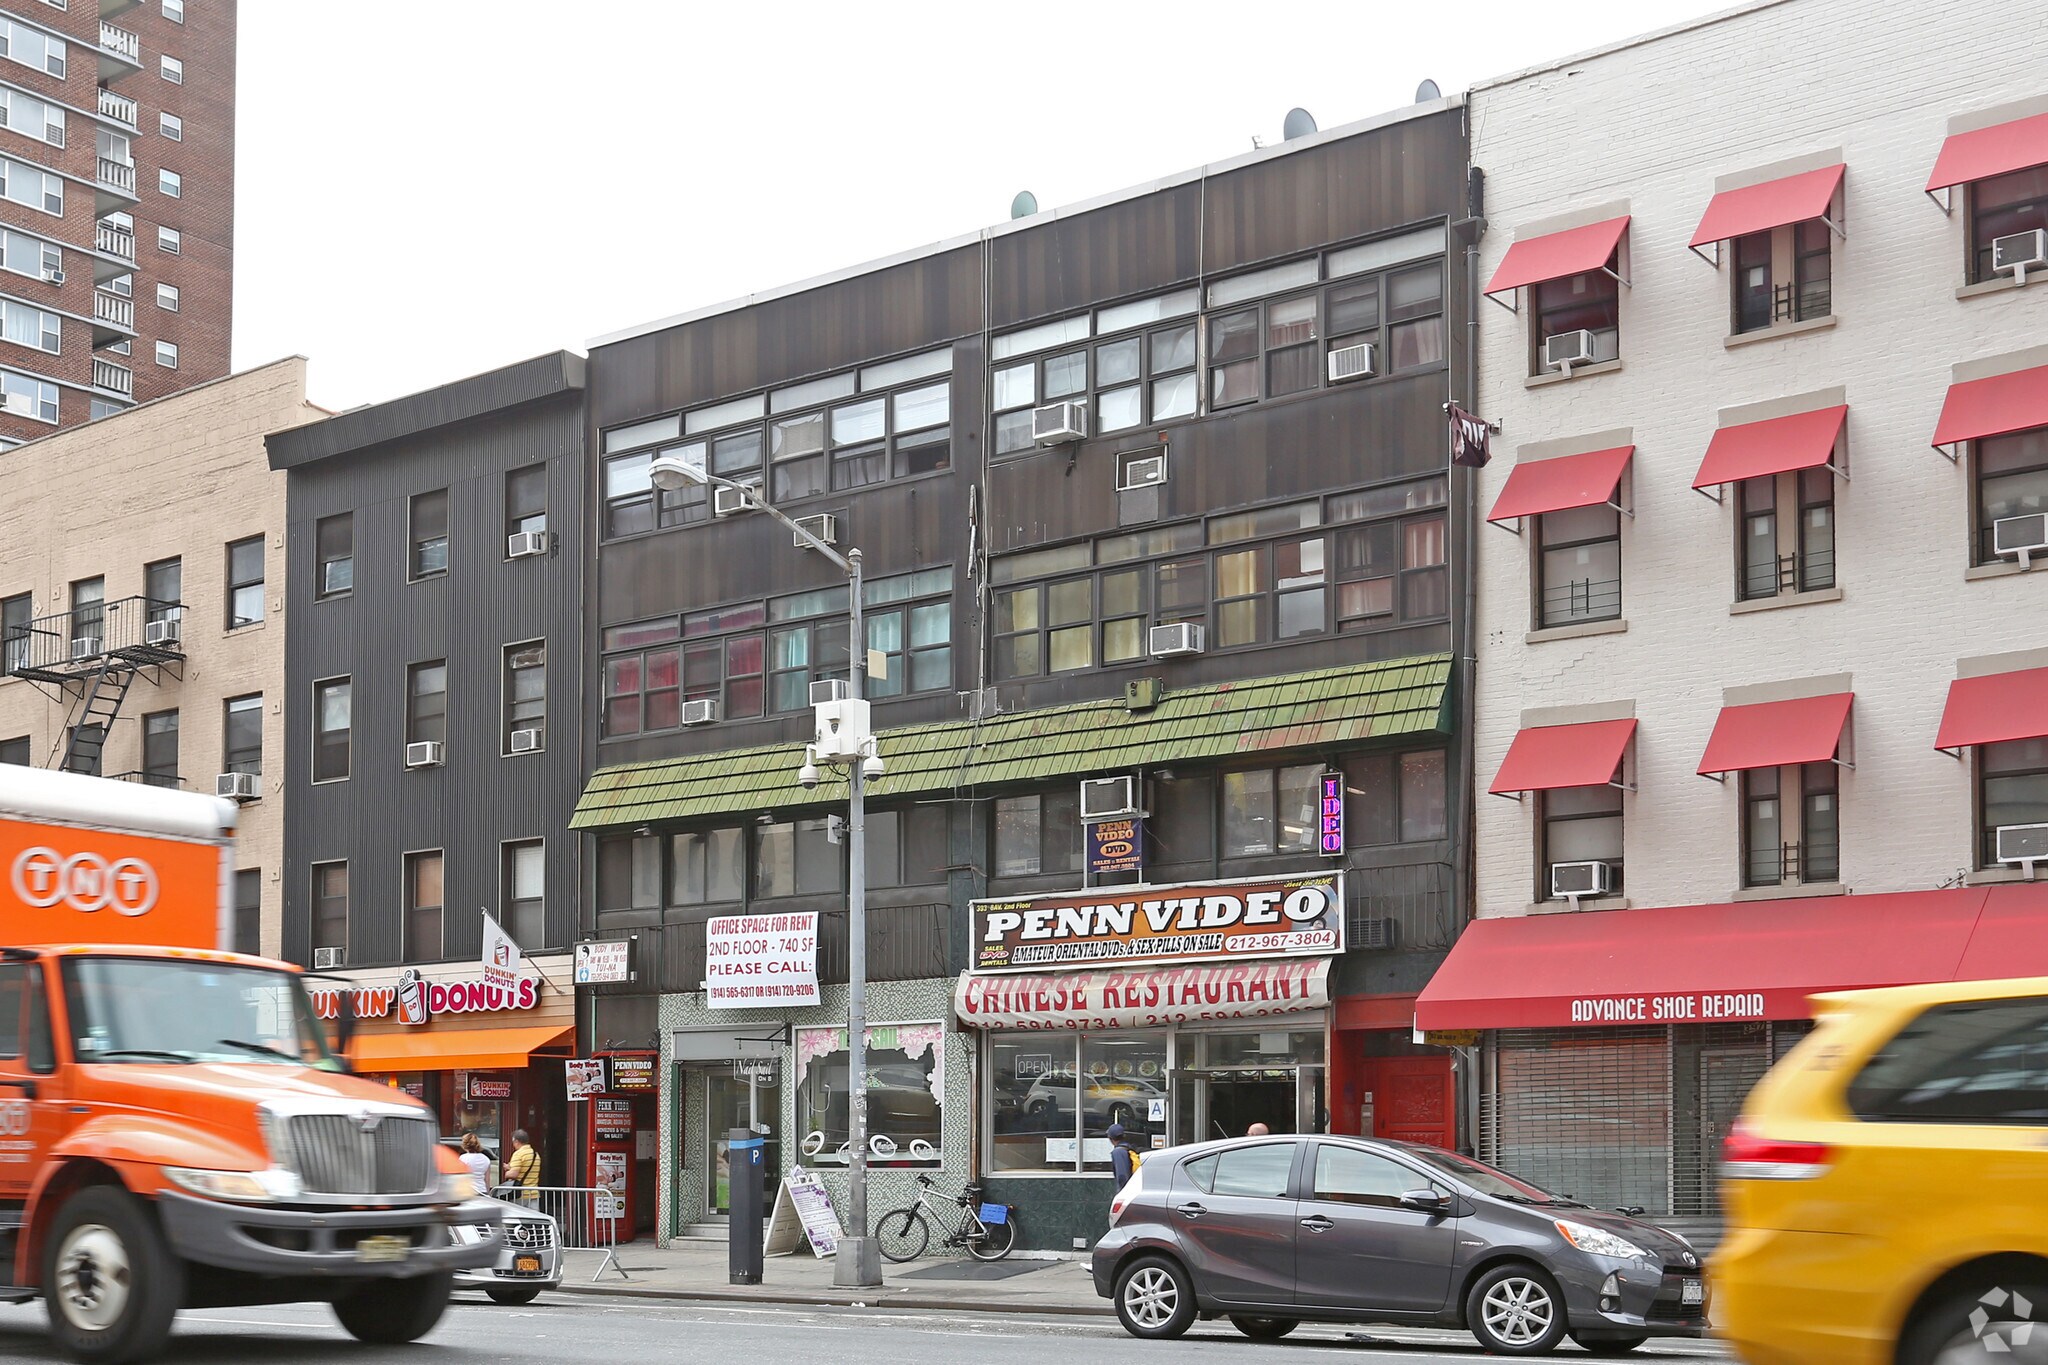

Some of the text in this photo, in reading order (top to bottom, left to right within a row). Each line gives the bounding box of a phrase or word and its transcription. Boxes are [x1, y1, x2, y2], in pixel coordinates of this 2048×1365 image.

[1323, 780, 1340, 851] IDEO
[1098, 821, 1132, 832] PENN
[1096, 830, 1134, 841] VIDEO
[1105, 845, 1127, 854] DVD
[22, 858, 150, 904] TNT
[984, 888, 1327, 942] PENN VIDEO
[711, 915, 814, 935] OFFICE SPACE FOR RENT
[709, 941, 730, 956] 2ND
[733, 939, 768, 955] FLOOR
[779, 937, 799, 953] 740
[801, 937, 814, 952] SF
[1013, 946, 1055, 962] AMATEUR
[1057, 942, 1099, 959] ORIENTAL
[1127, 938, 1135, 954] &
[1136, 939, 1155, 954] SEX
[1156, 938, 1181, 953] PILLS
[1183, 936, 1198, 951] ON
[1199, 934, 1222, 951] SALE
[1230, 932, 1331, 950] 212-967-3804
[980, 951, 1009, 960] DVD
[484, 966, 517, 980] DUNKIN'
[709, 961, 812, 976] PLEASE CALL:
[484, 975, 515, 988] DONUTS
[965, 961, 1321, 1014] CHINESE RESTAURANT
[307, 978, 533, 1018] UNKIN' DONUTS
[711, 984, 814, 999] (914) 565-6317 OR (914) 720-9206
[1571, 993, 1764, 1022] ADVANCE SHOE REPAIR
[871, 1028, 900, 1050] SAIL
[614, 1061, 652, 1070] PENN VIDEO
[736, 1058, 774, 1075] Nail Sail
[1018, 1060, 1048, 1075] OPEN
[482, 1089, 510, 1097] DONUTS
[1151, 1102, 1162, 1115] A
[752, 1149, 760, 1163] P
